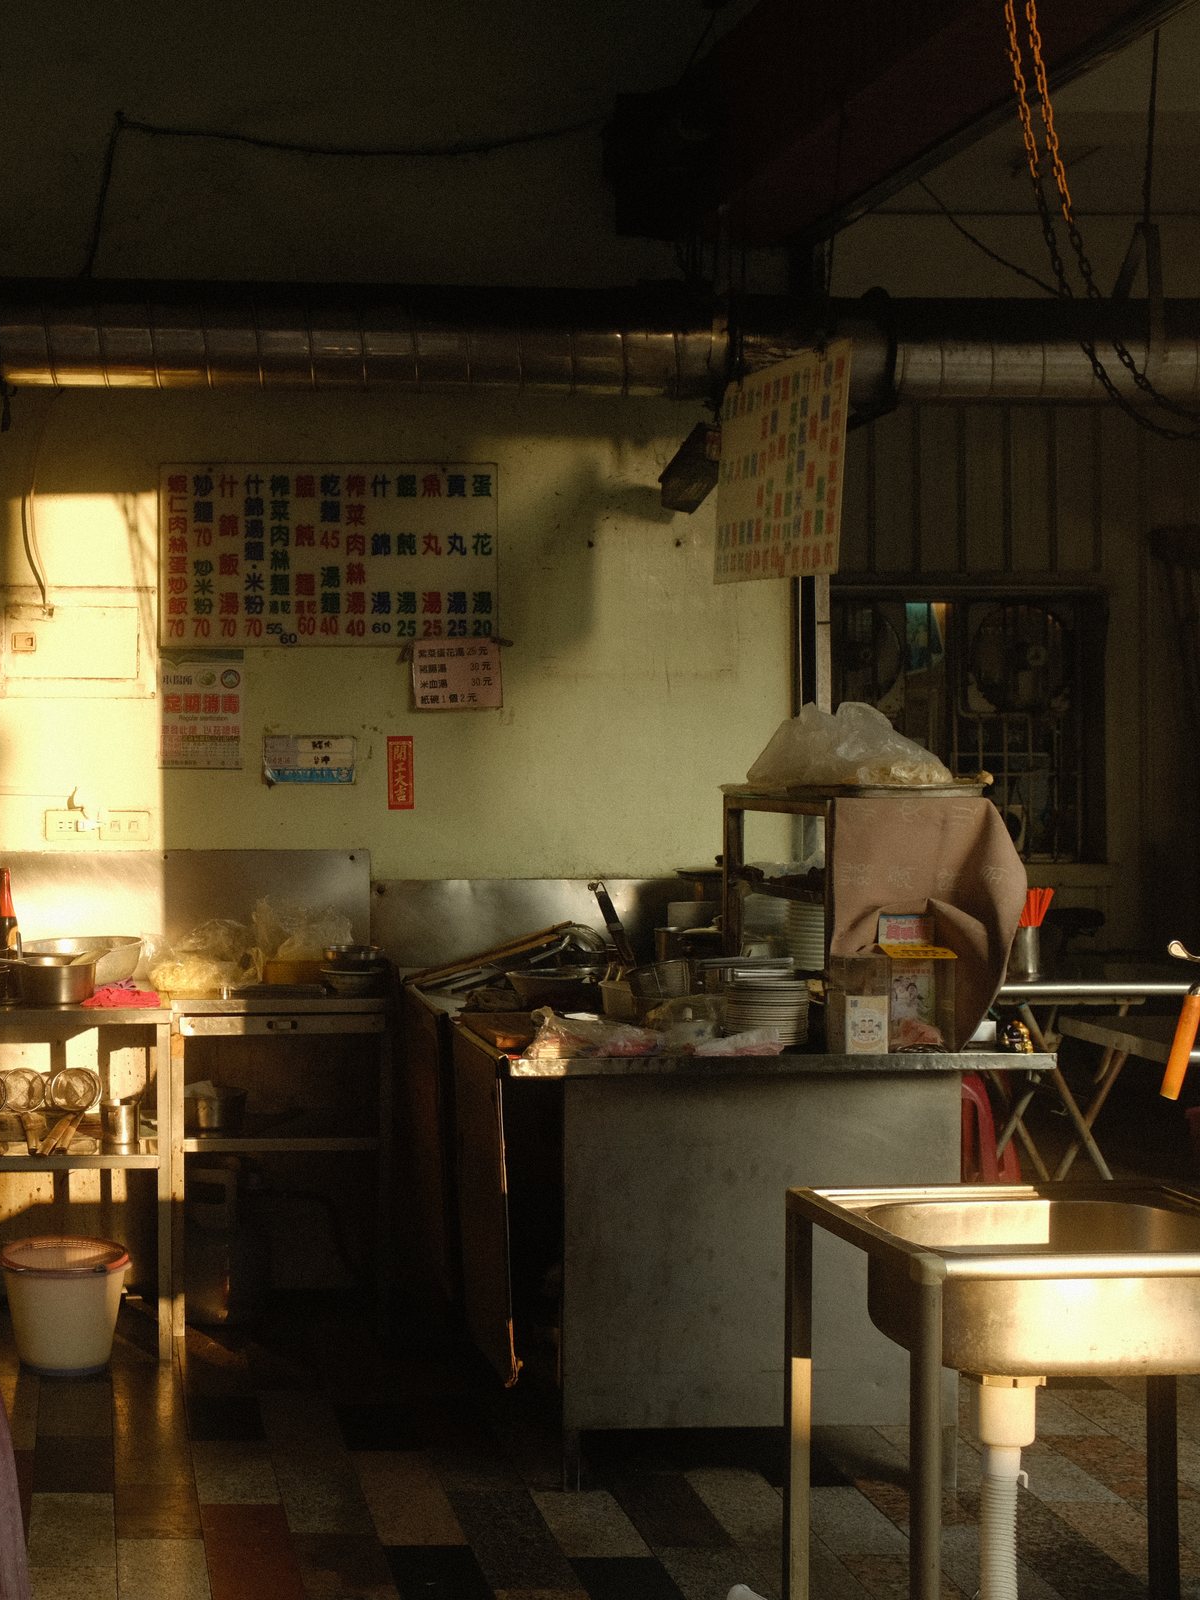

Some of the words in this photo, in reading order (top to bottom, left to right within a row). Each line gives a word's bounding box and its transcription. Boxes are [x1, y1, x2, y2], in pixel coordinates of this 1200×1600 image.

[193, 474, 213, 523] 炒麵
[320, 474, 340, 523] 乾麵
[167, 474, 188, 615] 蝦仁肉絲蛋炒飯
[194, 528, 213, 547] 70
[320, 530, 339, 549] 45
[345, 474, 366, 615] 榨菜肉絲湯
[371, 474, 391, 615] 什錦湯
[397, 474, 417, 615] 餛飩湯
[422, 474, 442, 615] 魚丸湯
[447, 474, 467, 615] 貢丸湯
[472, 474, 492, 615] 蛋花湯
[193, 559, 213, 615] 炒米粉
[320, 566, 340, 615] 湯麵
[168, 618, 185, 637] 70
[193, 618, 210, 637] 70
[220, 618, 236, 637] 70
[246, 618, 262, 637] 70
[266, 623, 283, 635] 55
[279, 633, 297, 645] 60
[298, 616, 315, 635] 60
[320, 615, 338, 635] 40
[346, 620, 365, 637] 40
[372, 623, 391, 634] 60
[397, 620, 416, 637] 25
[422, 620, 442, 637] 25
[447, 620, 467, 637] 25
[472, 620, 492, 637] 20
[163, 692, 240, 714] 定期消毒
[393, 745, 408, 802] 開工大吉
